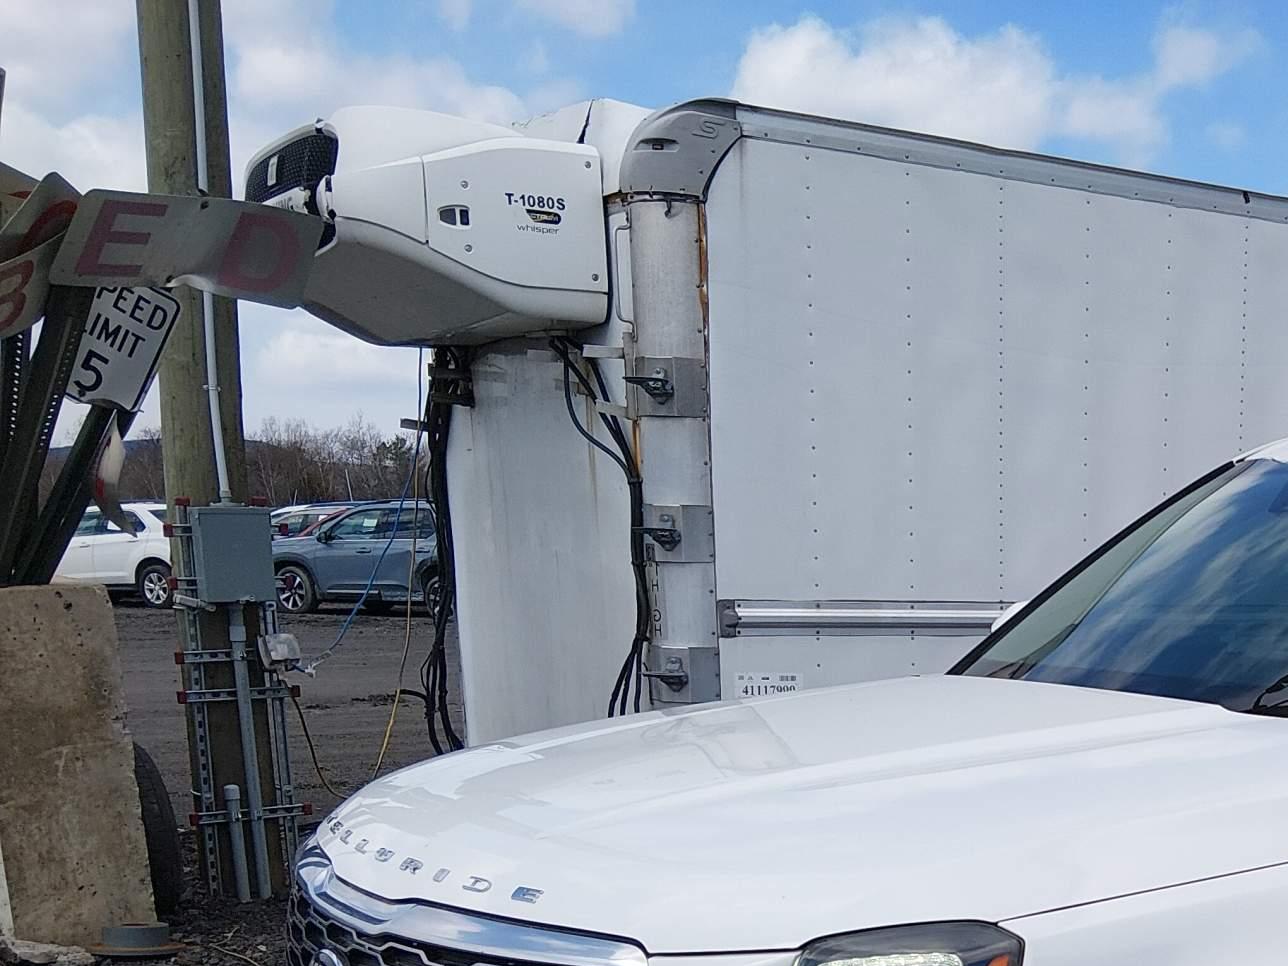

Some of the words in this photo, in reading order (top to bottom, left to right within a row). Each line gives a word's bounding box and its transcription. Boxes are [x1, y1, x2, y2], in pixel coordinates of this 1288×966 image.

[504, 192, 566, 211] T-1080S
[517, 224, 560, 235] whisper
[96, 286, 168, 331] PEED
[84, 312, 146, 358] IMIT
[73, 349, 110, 392] 5
